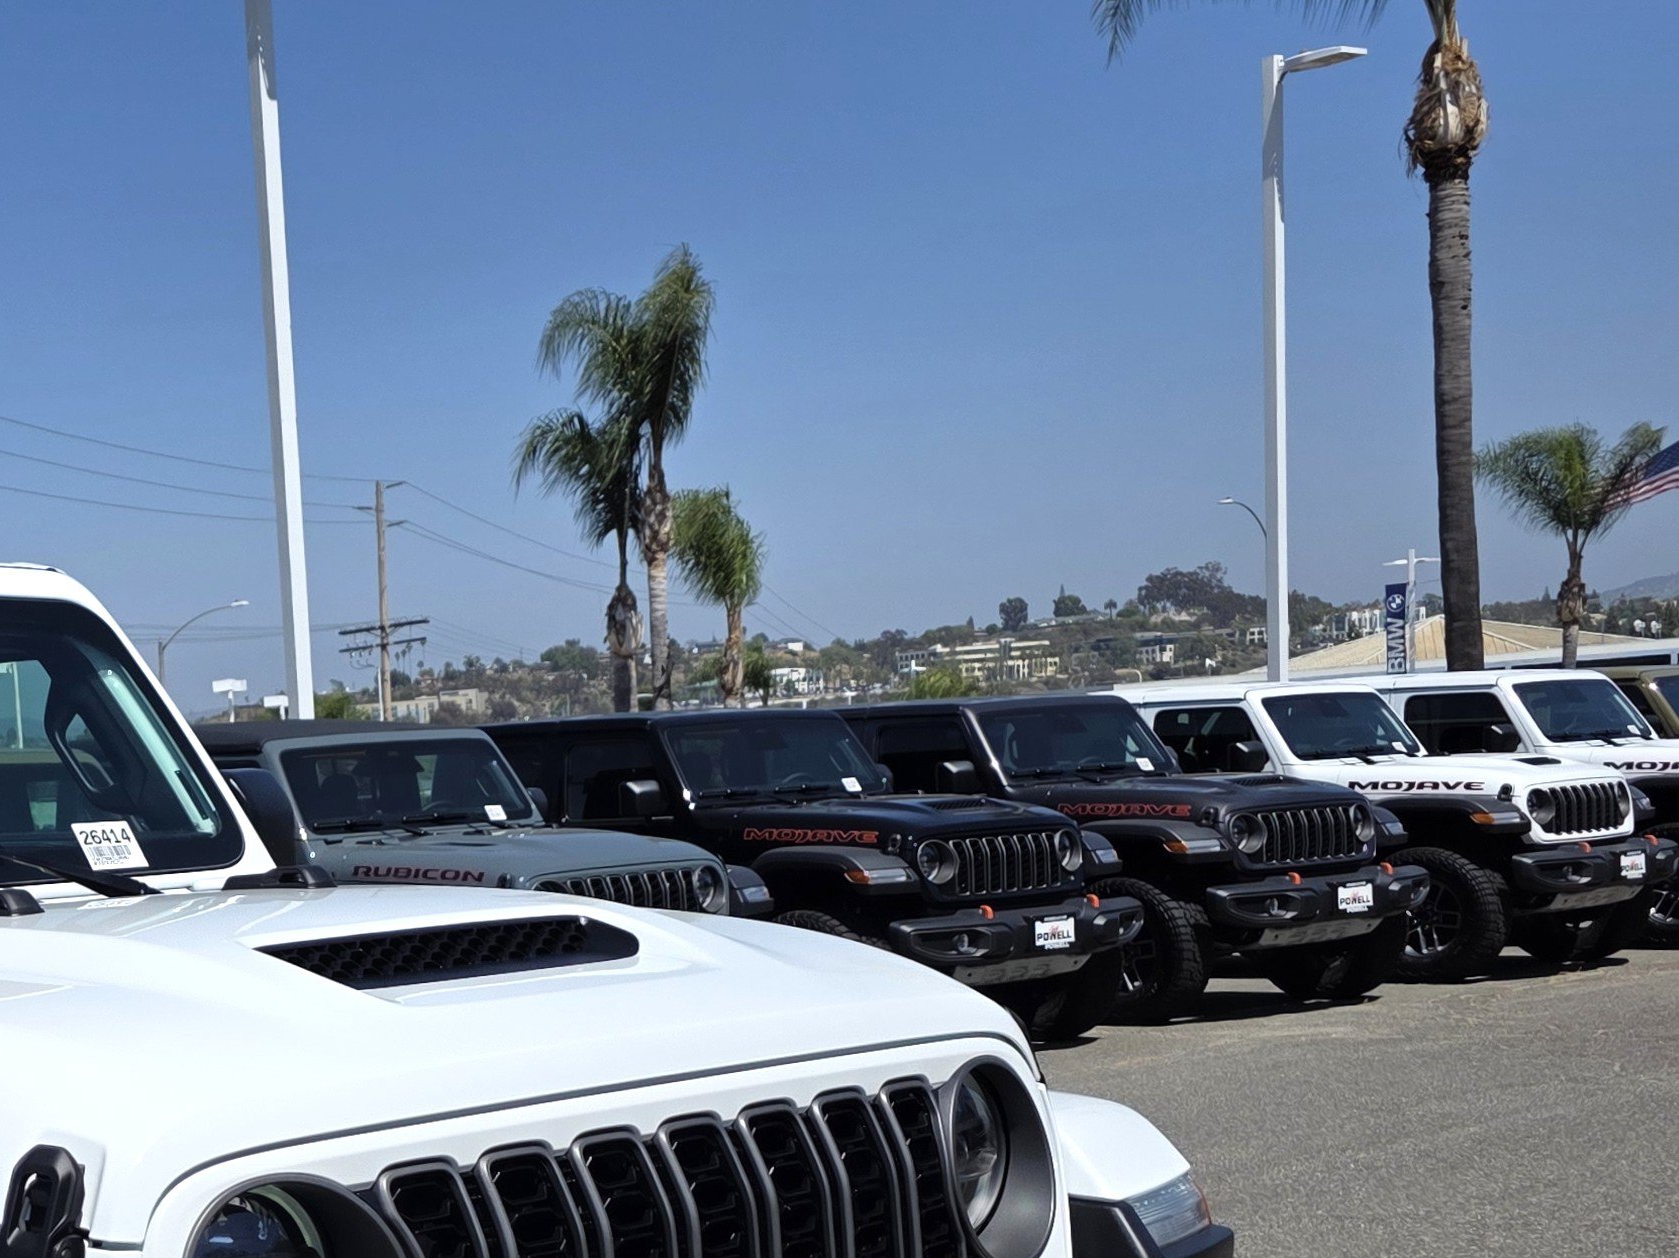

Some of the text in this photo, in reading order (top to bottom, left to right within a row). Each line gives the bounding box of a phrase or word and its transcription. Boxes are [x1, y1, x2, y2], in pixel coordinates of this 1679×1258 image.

[1387, 618, 1406, 673] BMW
[1348, 781, 1485, 792] MOJAVE
[1058, 803, 1192, 817] MOJAVE
[79, 828, 131, 846] 26414
[743, 828, 879, 844] MOJAVE
[352, 865, 485, 882] RUBICON
